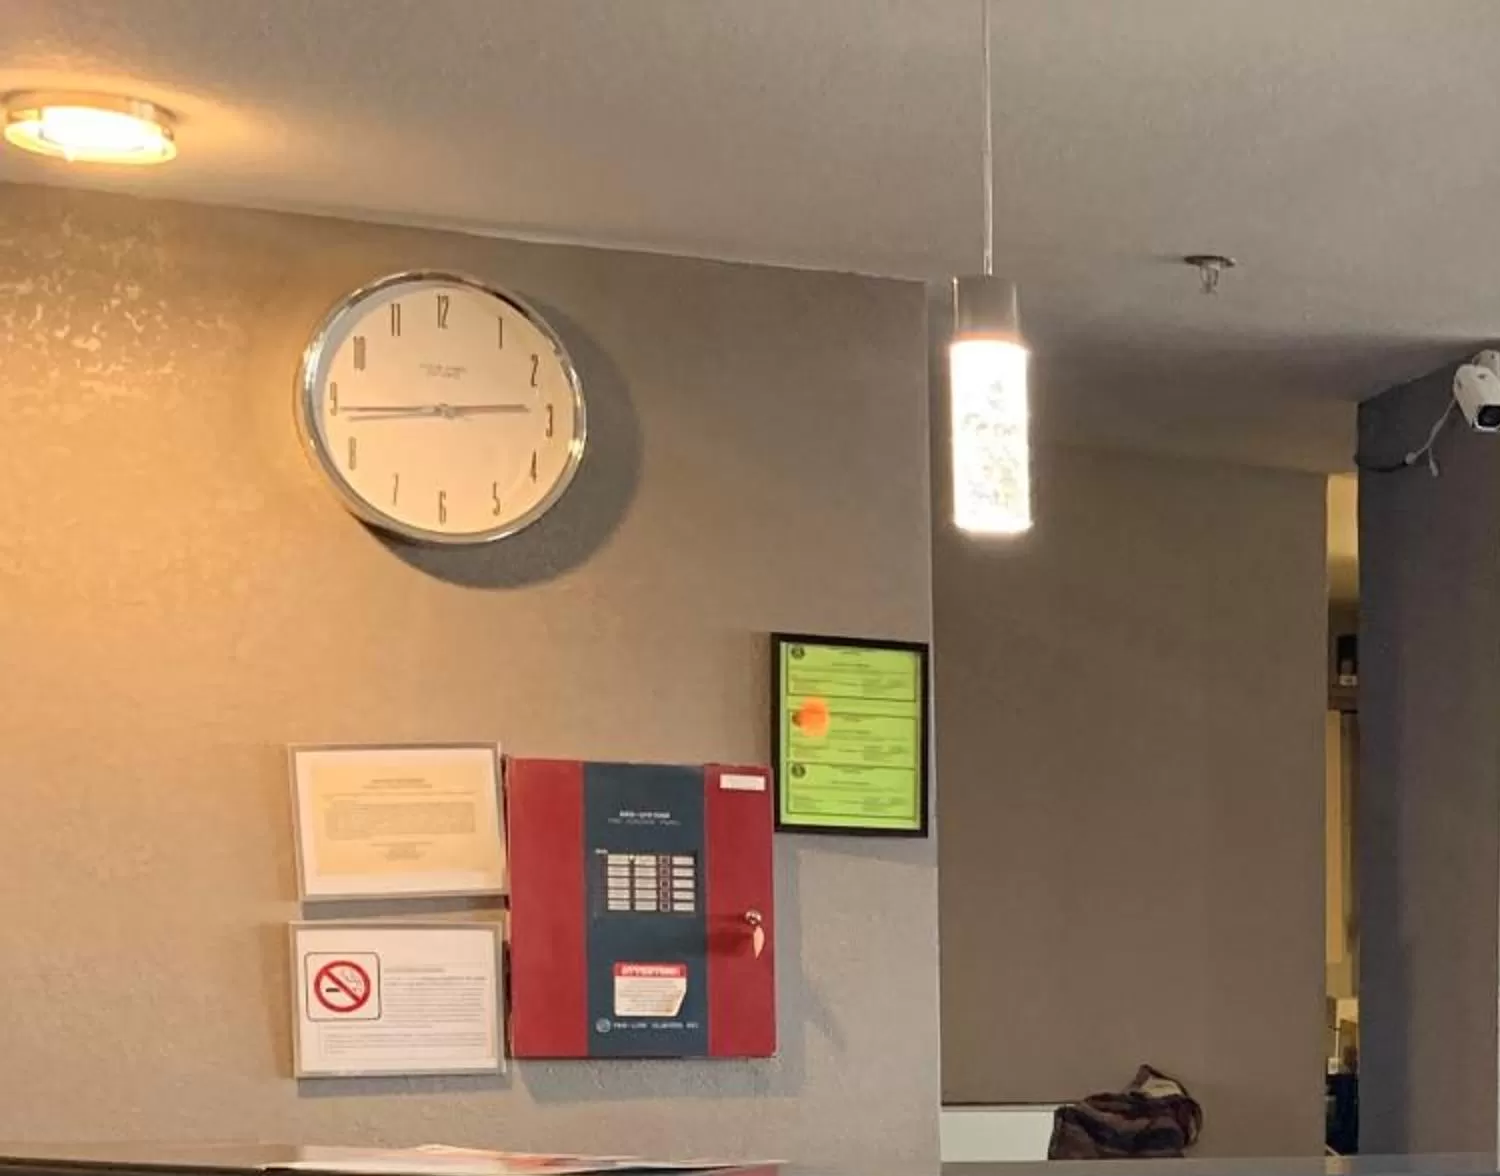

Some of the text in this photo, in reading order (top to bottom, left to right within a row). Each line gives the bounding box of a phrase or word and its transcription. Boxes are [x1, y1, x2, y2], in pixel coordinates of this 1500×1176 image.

[390, 303, 401, 337] 11
[437, 294, 449, 329] 12
[530, 353, 539, 388] 2
[329, 381, 338, 416] 9
[545, 403, 553, 438] 3
[530, 448, 538, 483] 4
[392, 472, 399, 506] 7
[491, 480, 501, 517] 5
[438, 490, 447, 525] 6
